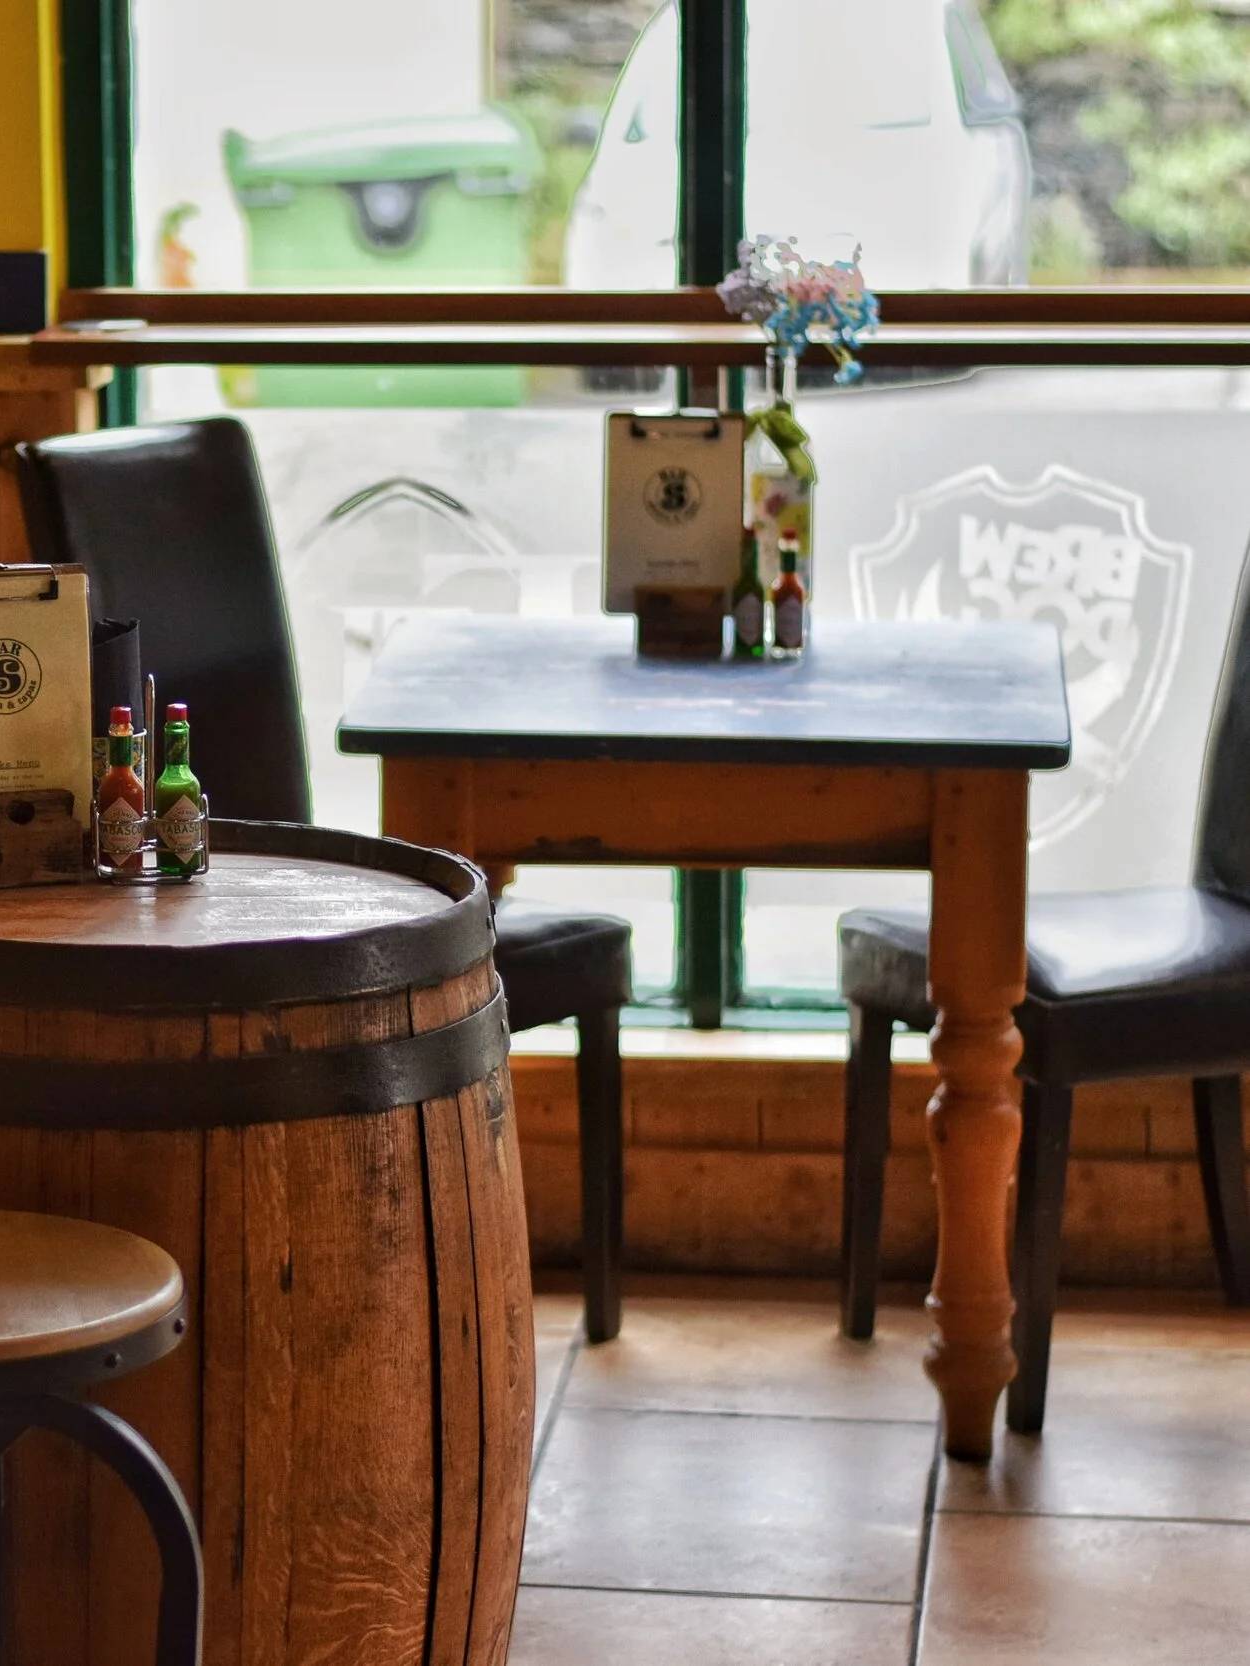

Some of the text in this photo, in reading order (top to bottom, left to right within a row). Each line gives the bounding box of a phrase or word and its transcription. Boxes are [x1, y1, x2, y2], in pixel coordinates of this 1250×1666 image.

[7, 700, 17, 710] &
[17, 679, 38, 705] tapas
[16, 759, 41, 770] Menu
[161, 822, 201, 835] TABASC
